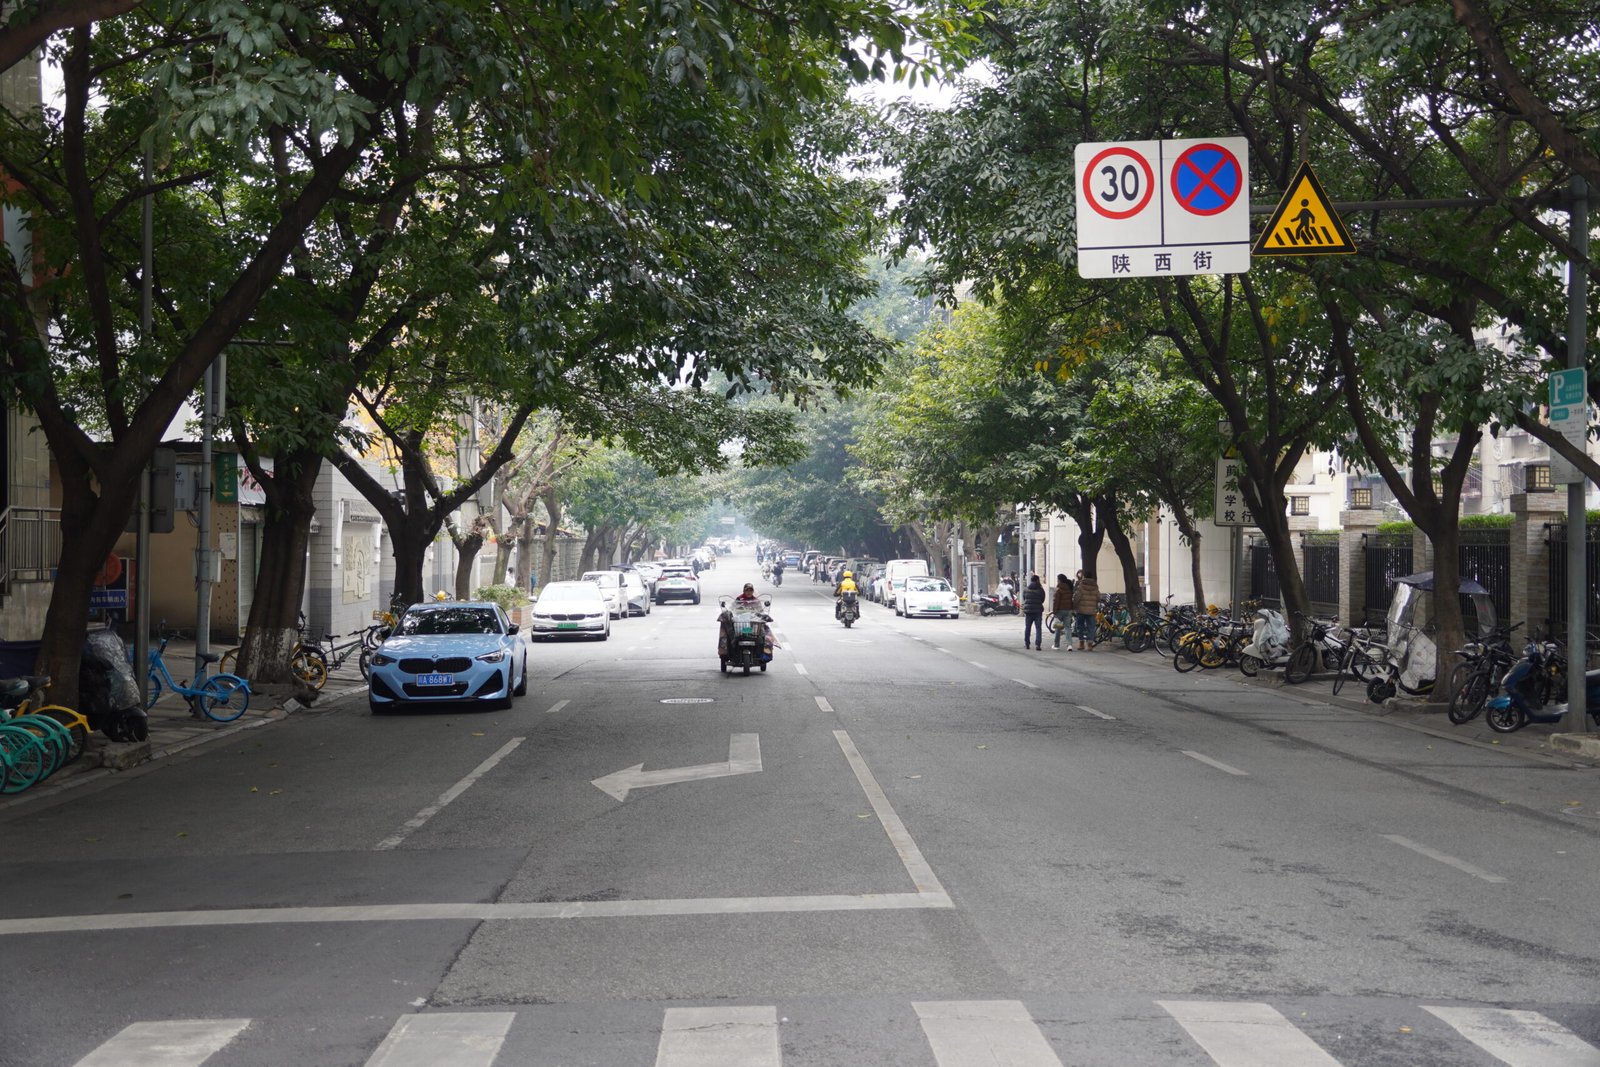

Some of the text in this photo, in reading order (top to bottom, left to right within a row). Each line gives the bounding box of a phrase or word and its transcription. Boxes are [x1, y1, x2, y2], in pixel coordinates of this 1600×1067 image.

[1100, 164, 1139, 202] 30
[1111, 250, 1213, 274] 陕西街
[1553, 374, 1565, 403] P
